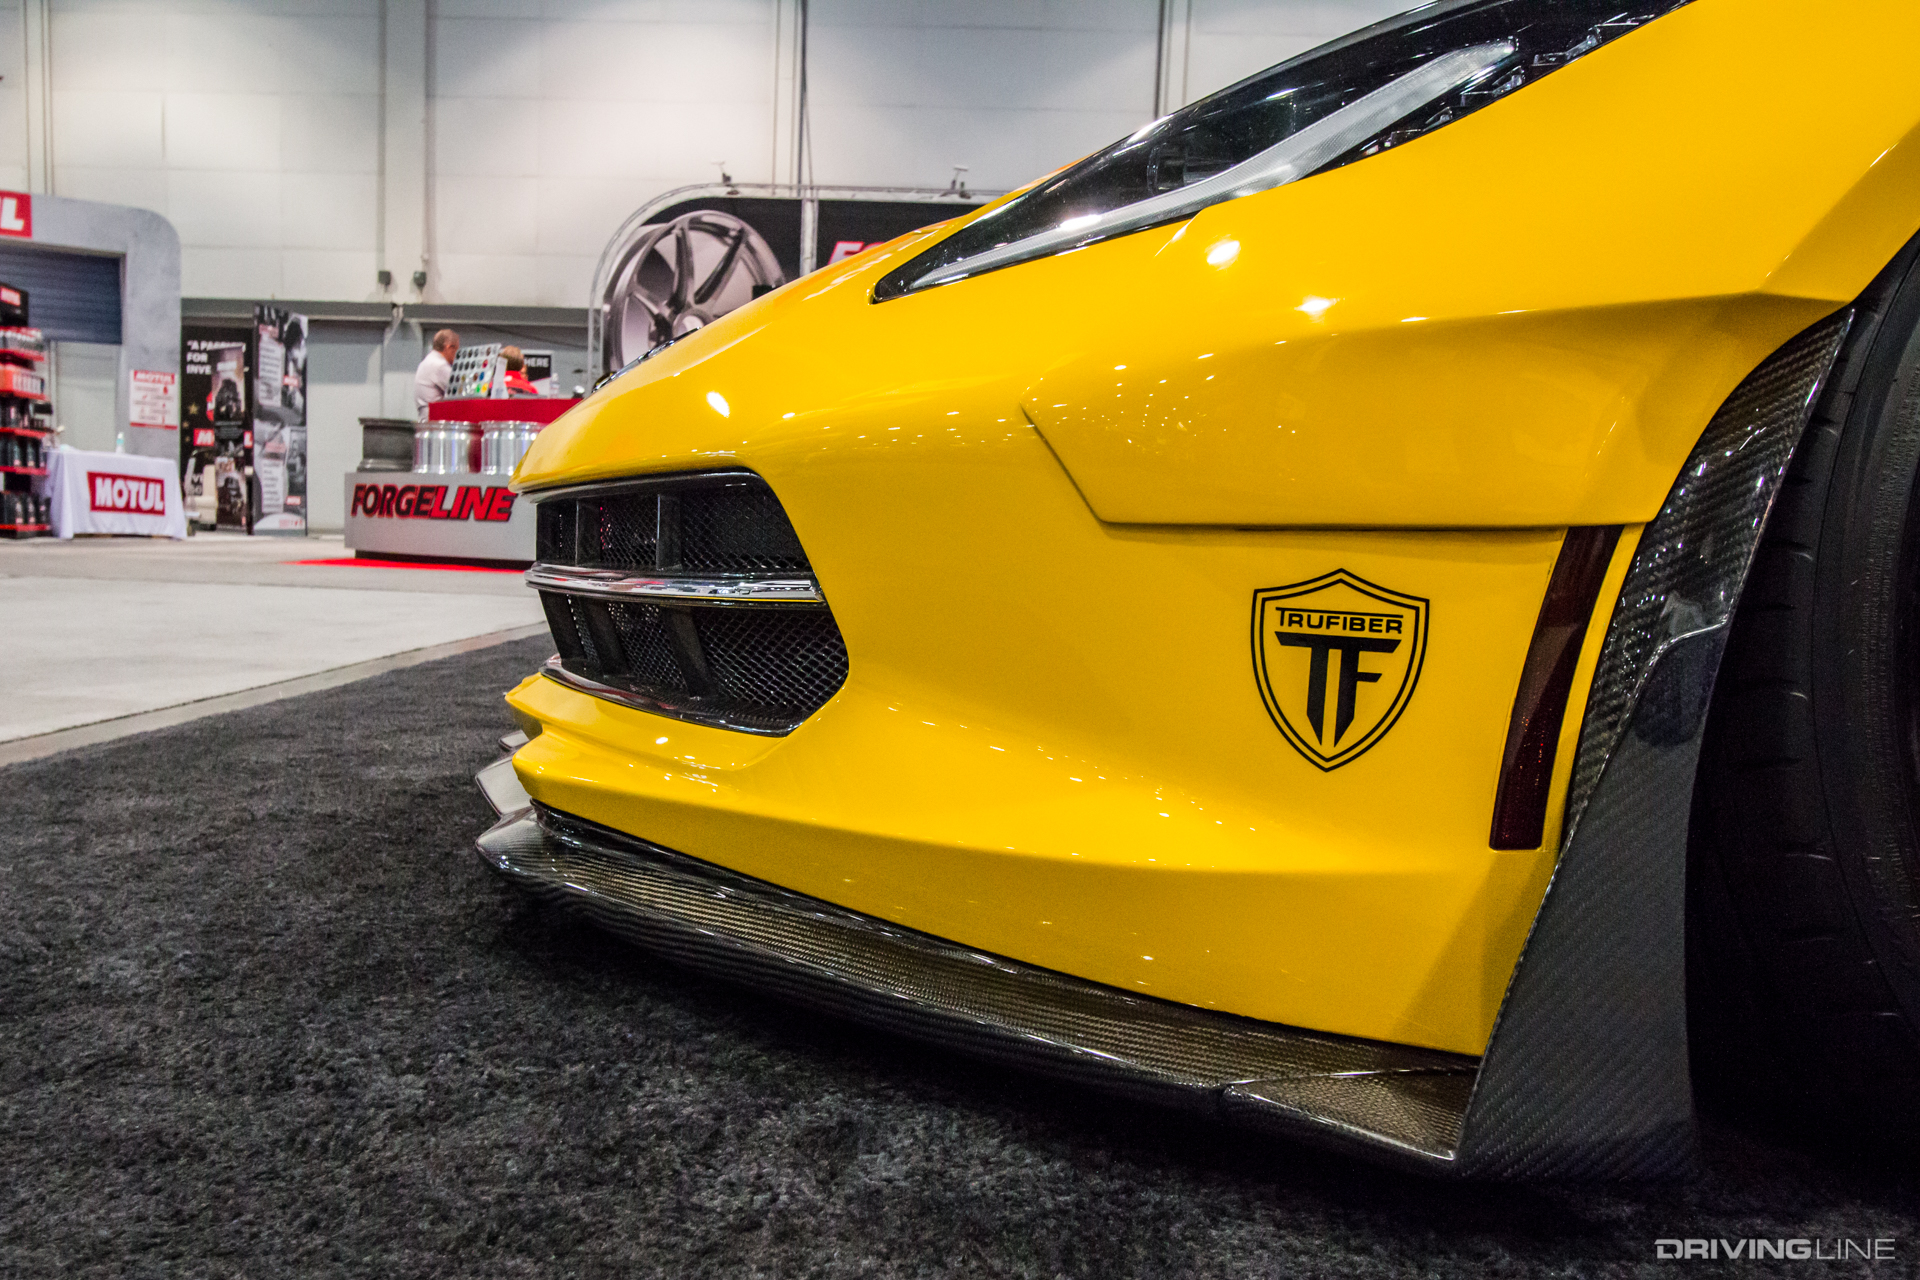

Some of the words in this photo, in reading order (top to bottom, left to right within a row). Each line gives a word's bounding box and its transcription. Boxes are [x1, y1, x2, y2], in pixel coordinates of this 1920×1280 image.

[187, 352, 208, 363] FOR
[94, 476, 165, 511] MOTUL
[351, 484, 518, 522] FORGELINE
[1276, 607, 1404, 635] TRUFIBER
